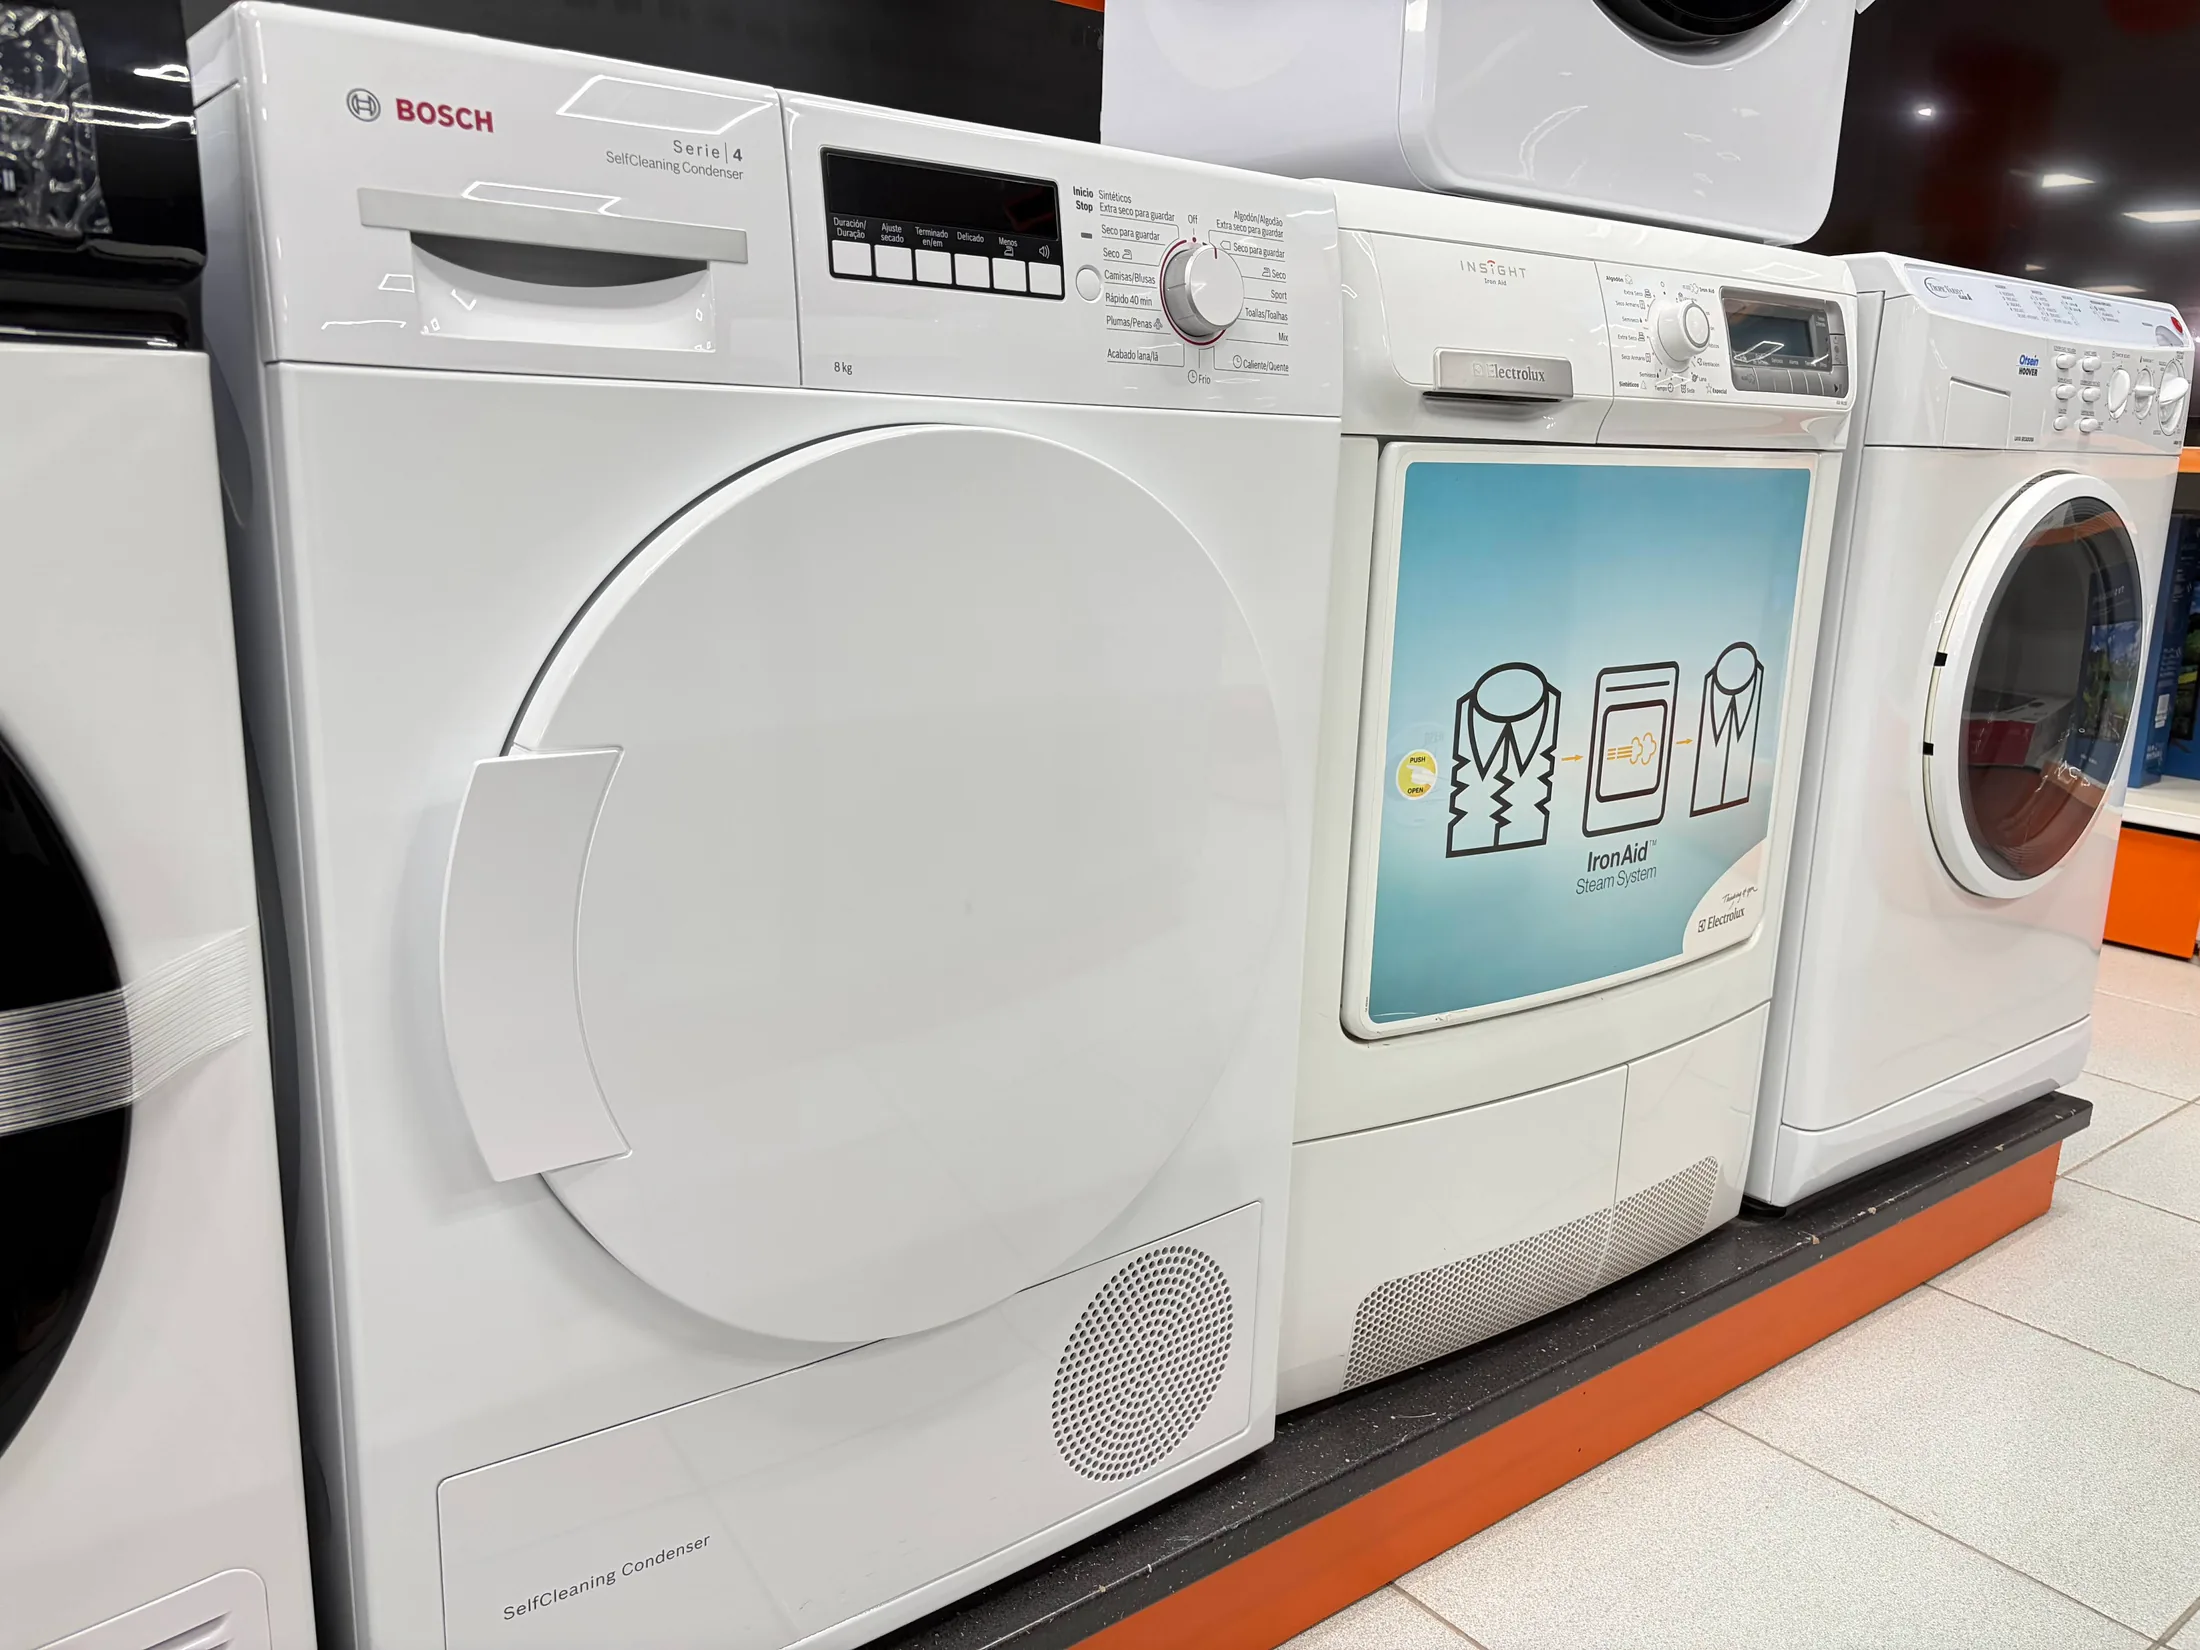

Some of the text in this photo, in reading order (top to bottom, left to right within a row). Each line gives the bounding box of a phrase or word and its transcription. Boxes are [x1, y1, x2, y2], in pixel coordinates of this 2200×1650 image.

[395, 97, 494, 133] BOSCH
[606, 150, 744, 181] SelfCleaning Condenser
[1073, 186, 1094, 199] Inicio
[1098, 189, 1132, 204] Sintéticos
[1075, 200, 1093, 213] Stop
[1099, 202, 1175, 222] Extra seco para guardar
[833, 217, 867, 231] Duración/
[1187, 214, 1198, 225] Off
[1233, 210, 1283, 227] Algodón/Algodão
[836, 226, 865, 239] Duração
[881, 222, 902, 234] Ajuste
[915, 226, 949, 239] Terminado
[1101, 224, 1160, 241] Seco para guardar
[1216, 219, 1284, 238] Extra seco para guardar
[880, 232, 904, 244] secado
[922, 237, 943, 248] en/em
[957, 231, 984, 244] Delicado
[998, 236, 1018, 247] Menos
[1103, 247, 1120, 259] Seco
[1233, 242, 1285, 259] Seco para guardar
[1104, 269, 1156, 285] Camisas/Blusas
[1271, 269, 1286, 280] Seco
[1105, 292, 1153, 306] Rápido 40 min
[1270, 289, 1287, 300] Sport
[1245, 307, 1288, 321] Toallas/Toalhas
[1106, 315, 1152, 329] Plumas/Penas
[1278, 332, 1289, 342] Mix
[1107, 348, 1136, 360] Acabado
[2019, 354, 2039, 367] Otsein
[834, 361, 853, 375] 8 kg
[1243, 359, 1289, 372] Caliente/Quente
[2018, 367, 2038, 376] HOOVER
[1486, 363, 1545, 382] Electrolux
[1409, 756, 1426, 764] PUSH
[1575, 866, 1657, 895] Steam System
[1707, 907, 1745, 930] Electrolux
[503, 1535, 711, 1620] SelfCleaning Condenser
